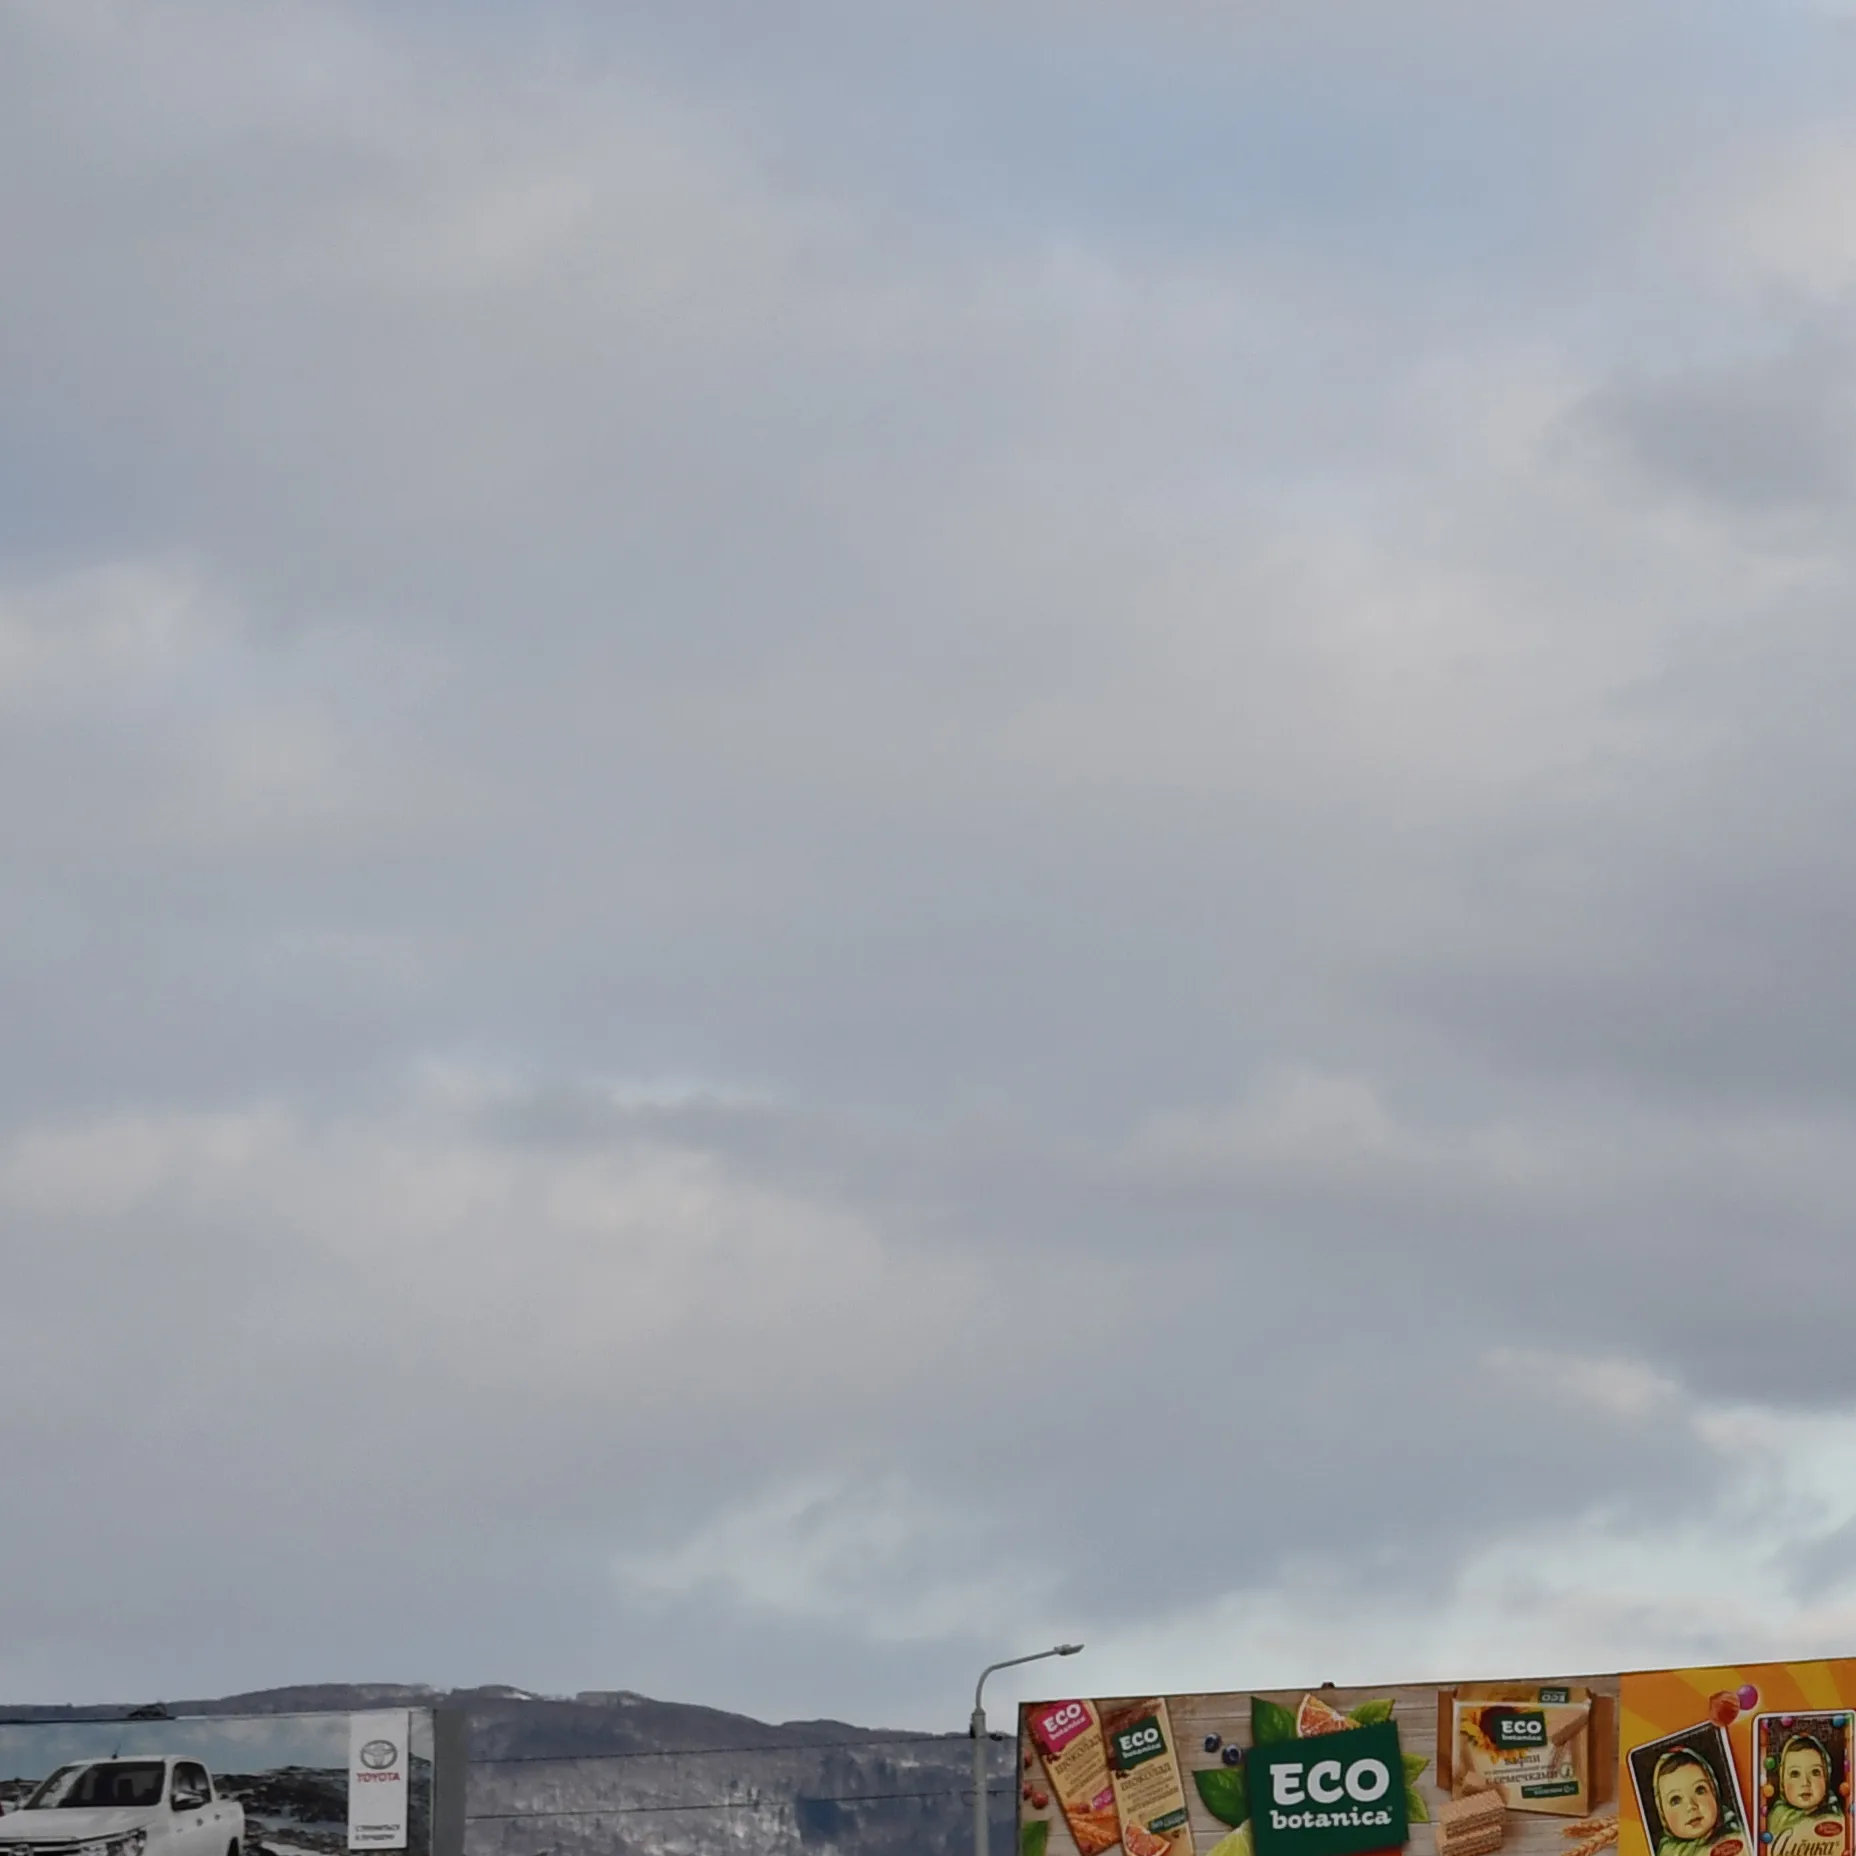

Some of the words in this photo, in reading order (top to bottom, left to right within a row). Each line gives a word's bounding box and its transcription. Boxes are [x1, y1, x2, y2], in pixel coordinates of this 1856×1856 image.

[1042, 1703, 1081, 1732] ECO
[1501, 1720, 1542, 1734] ECO
[1119, 1727, 1158, 1751] ECO
[356, 1772, 400, 1782] TOYOTA
[1269, 1757, 1390, 1806] ECO
[1269, 1806, 1392, 1830] botanica
